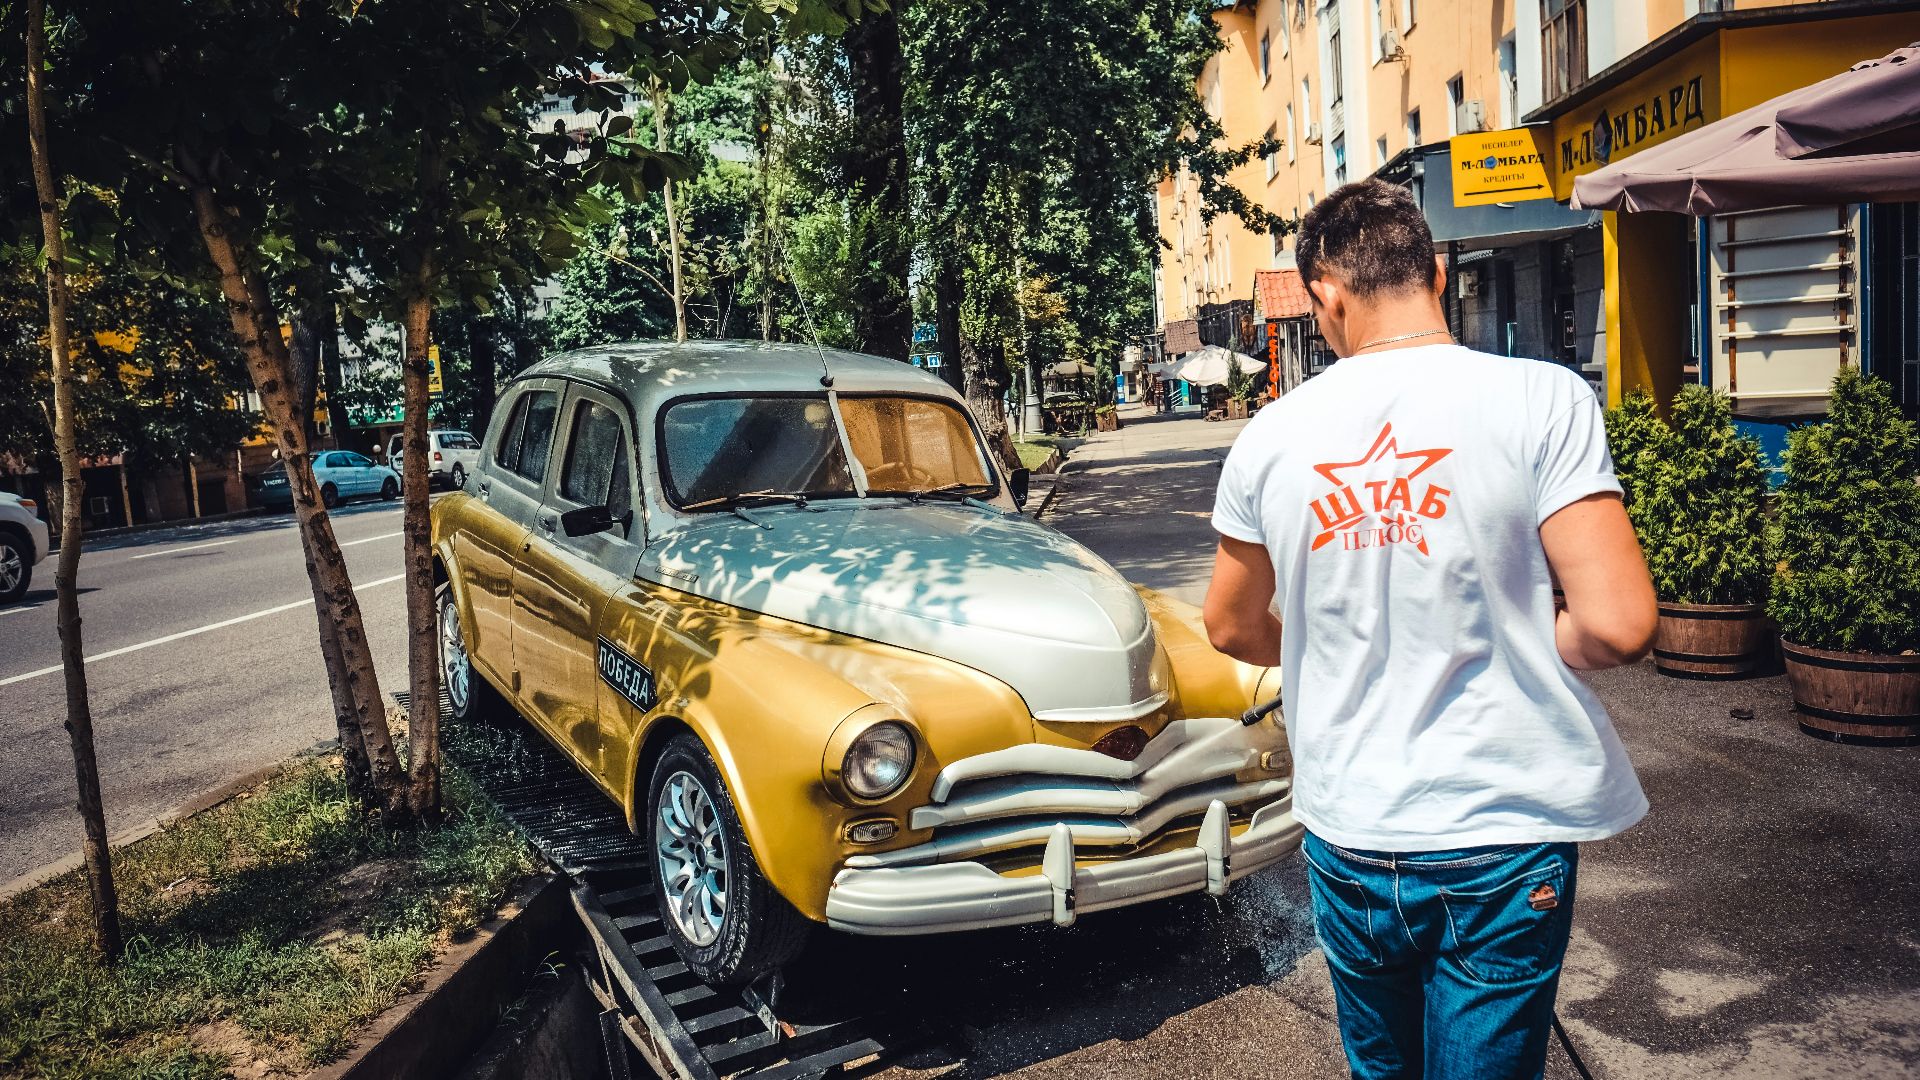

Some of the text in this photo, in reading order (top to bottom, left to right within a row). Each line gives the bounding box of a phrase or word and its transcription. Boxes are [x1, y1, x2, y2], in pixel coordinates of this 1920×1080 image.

[1483, 173, 1525, 184] КРЕДИТЫ
[1308, 477, 1452, 531] ШТАБ
[599, 645, 649, 705] ПОБЕДА
